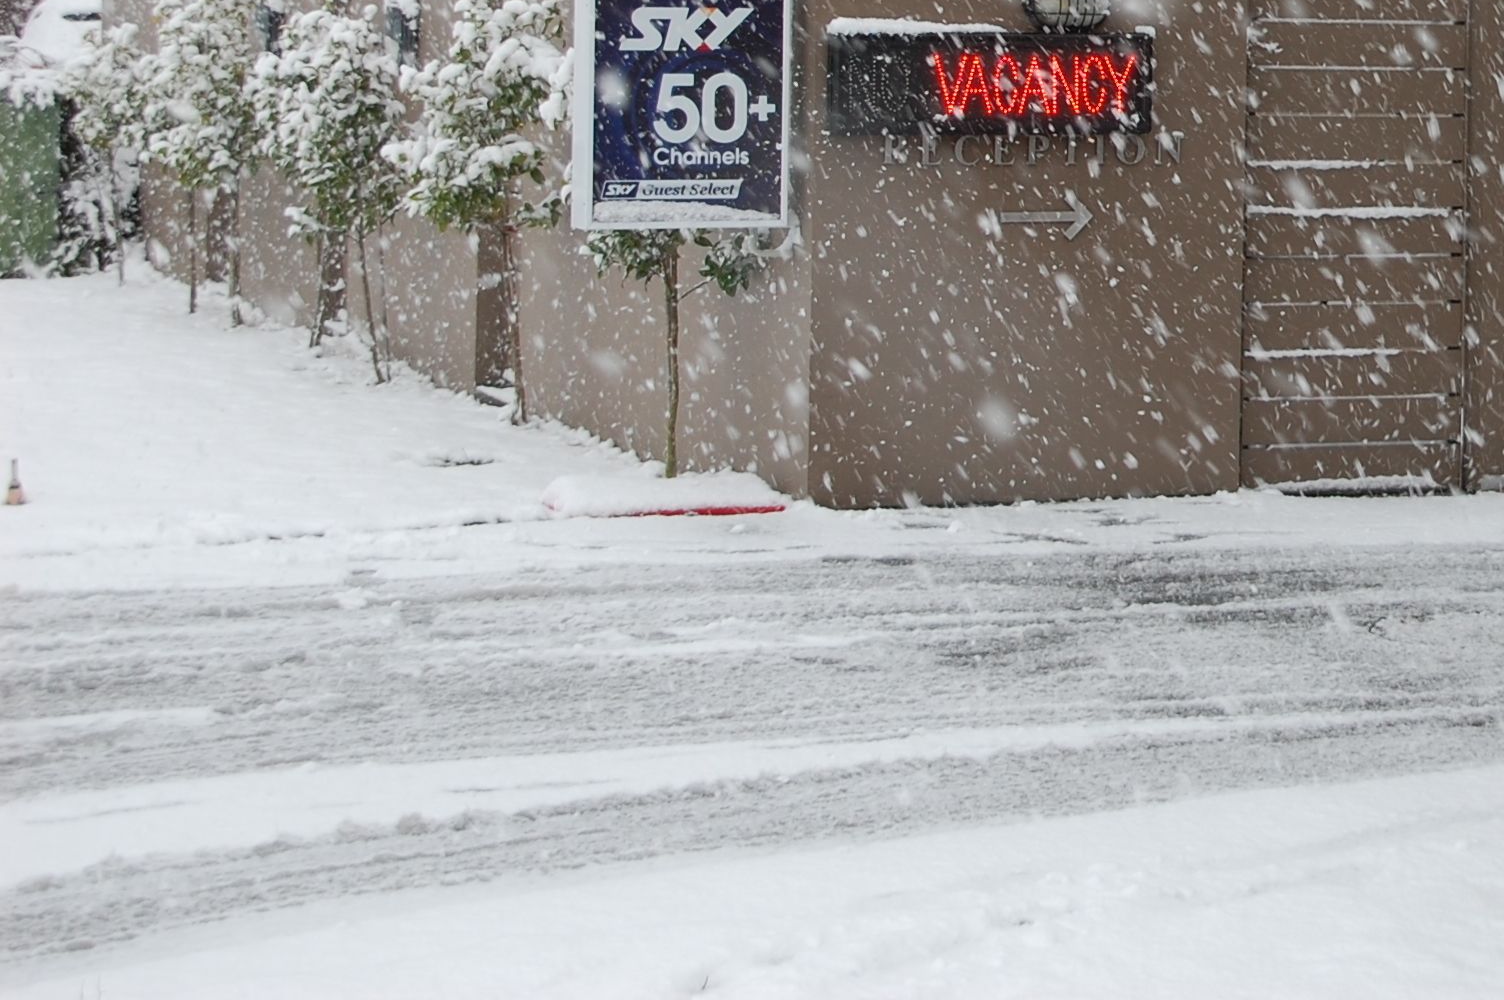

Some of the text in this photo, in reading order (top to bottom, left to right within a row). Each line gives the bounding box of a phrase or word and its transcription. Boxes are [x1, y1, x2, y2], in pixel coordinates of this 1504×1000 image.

[618, 6, 755, 51] SKY
[932, 50, 1138, 116] VACANCY
[652, 71, 776, 144] 50+
[652, 147, 750, 166] Channels
[882, 133, 1185, 167] RECEPTION
[605, 182, 735, 196] SKY Guest Select
